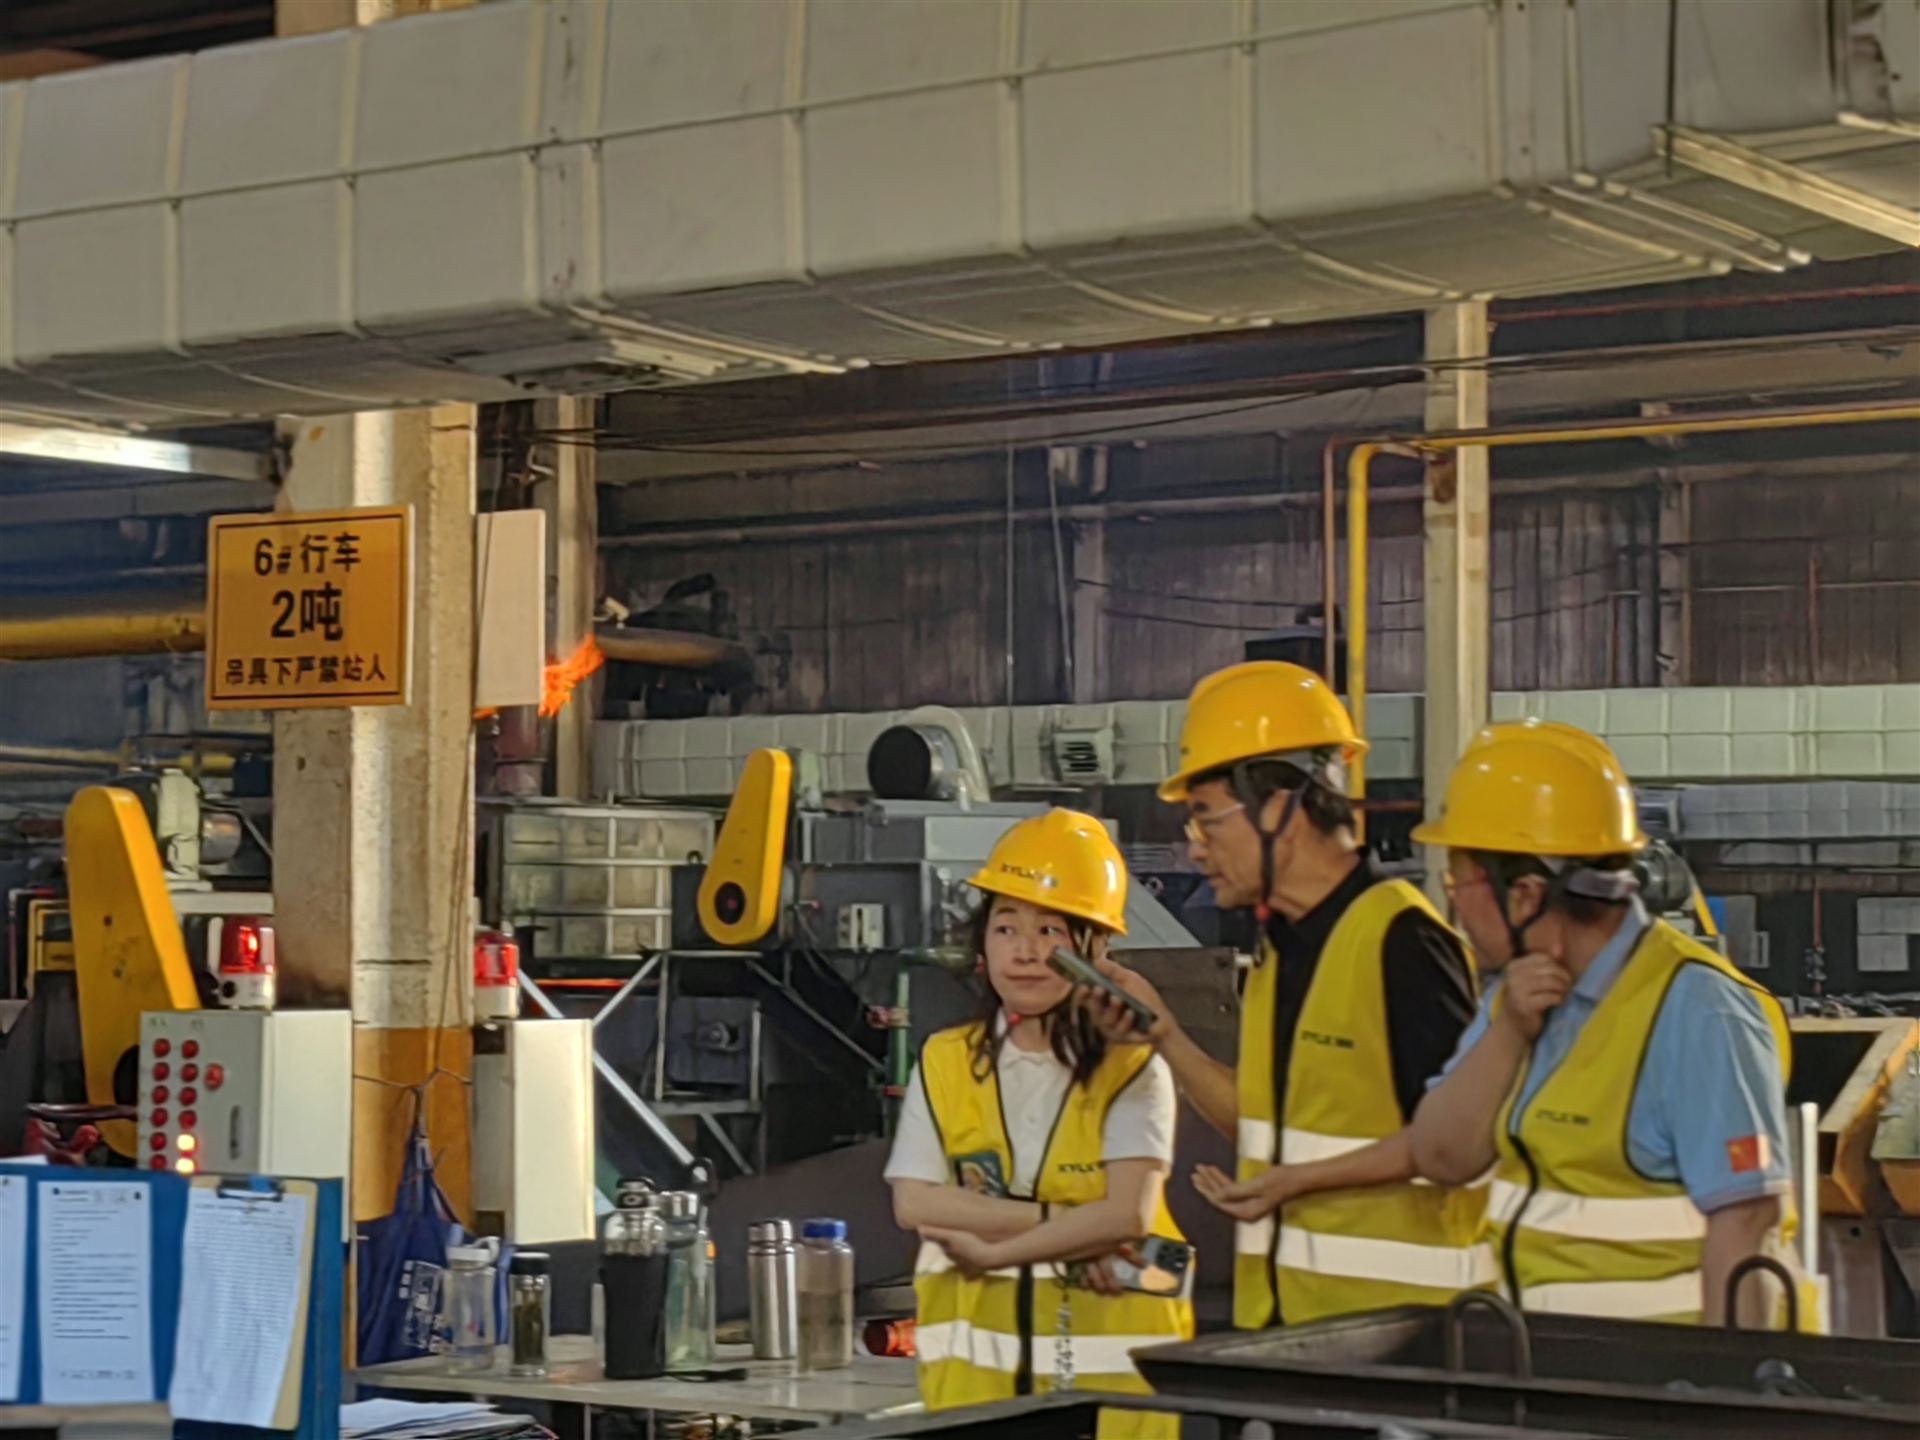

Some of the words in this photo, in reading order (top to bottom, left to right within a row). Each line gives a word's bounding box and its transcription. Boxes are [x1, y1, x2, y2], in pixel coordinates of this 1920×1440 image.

[271, 582, 343, 641] 2吨
[225, 653, 386, 685] 吊具下严禁站人
